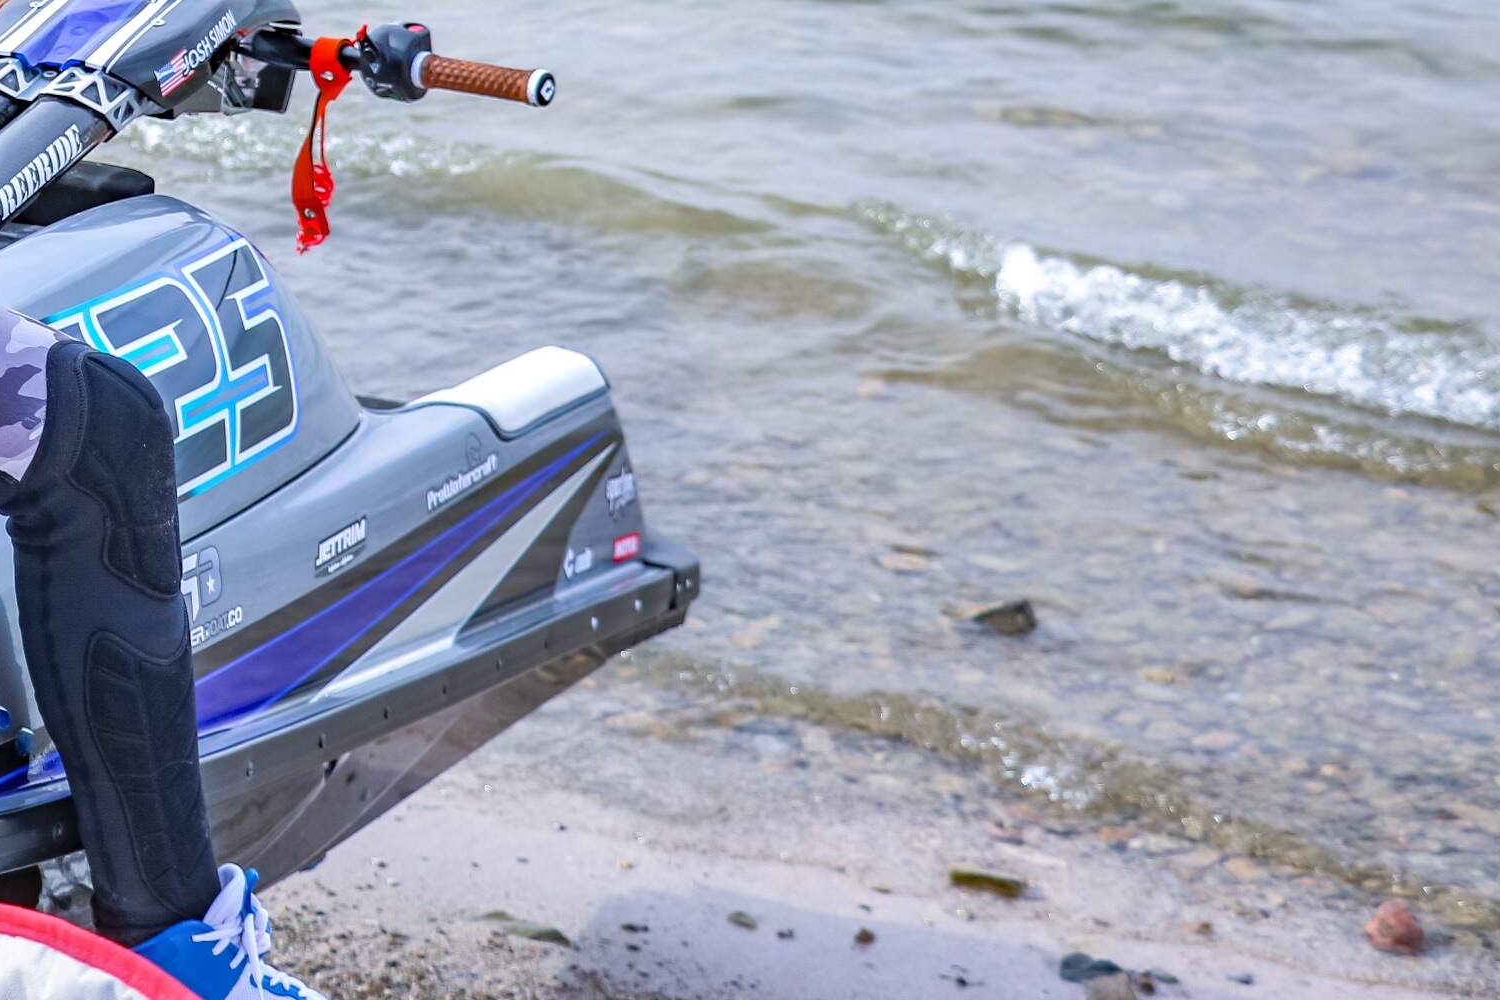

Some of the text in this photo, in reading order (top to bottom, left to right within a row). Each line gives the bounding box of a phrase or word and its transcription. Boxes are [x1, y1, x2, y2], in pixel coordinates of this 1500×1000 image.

[182, 9, 238, 76] JOSH SIMON
[42, 235, 299, 499] 25
[426, 453, 498, 511] ProWatercraft
[315, 518, 367, 567] JETTRIM
[190, 605, 243, 647] ERBOAT.CO
